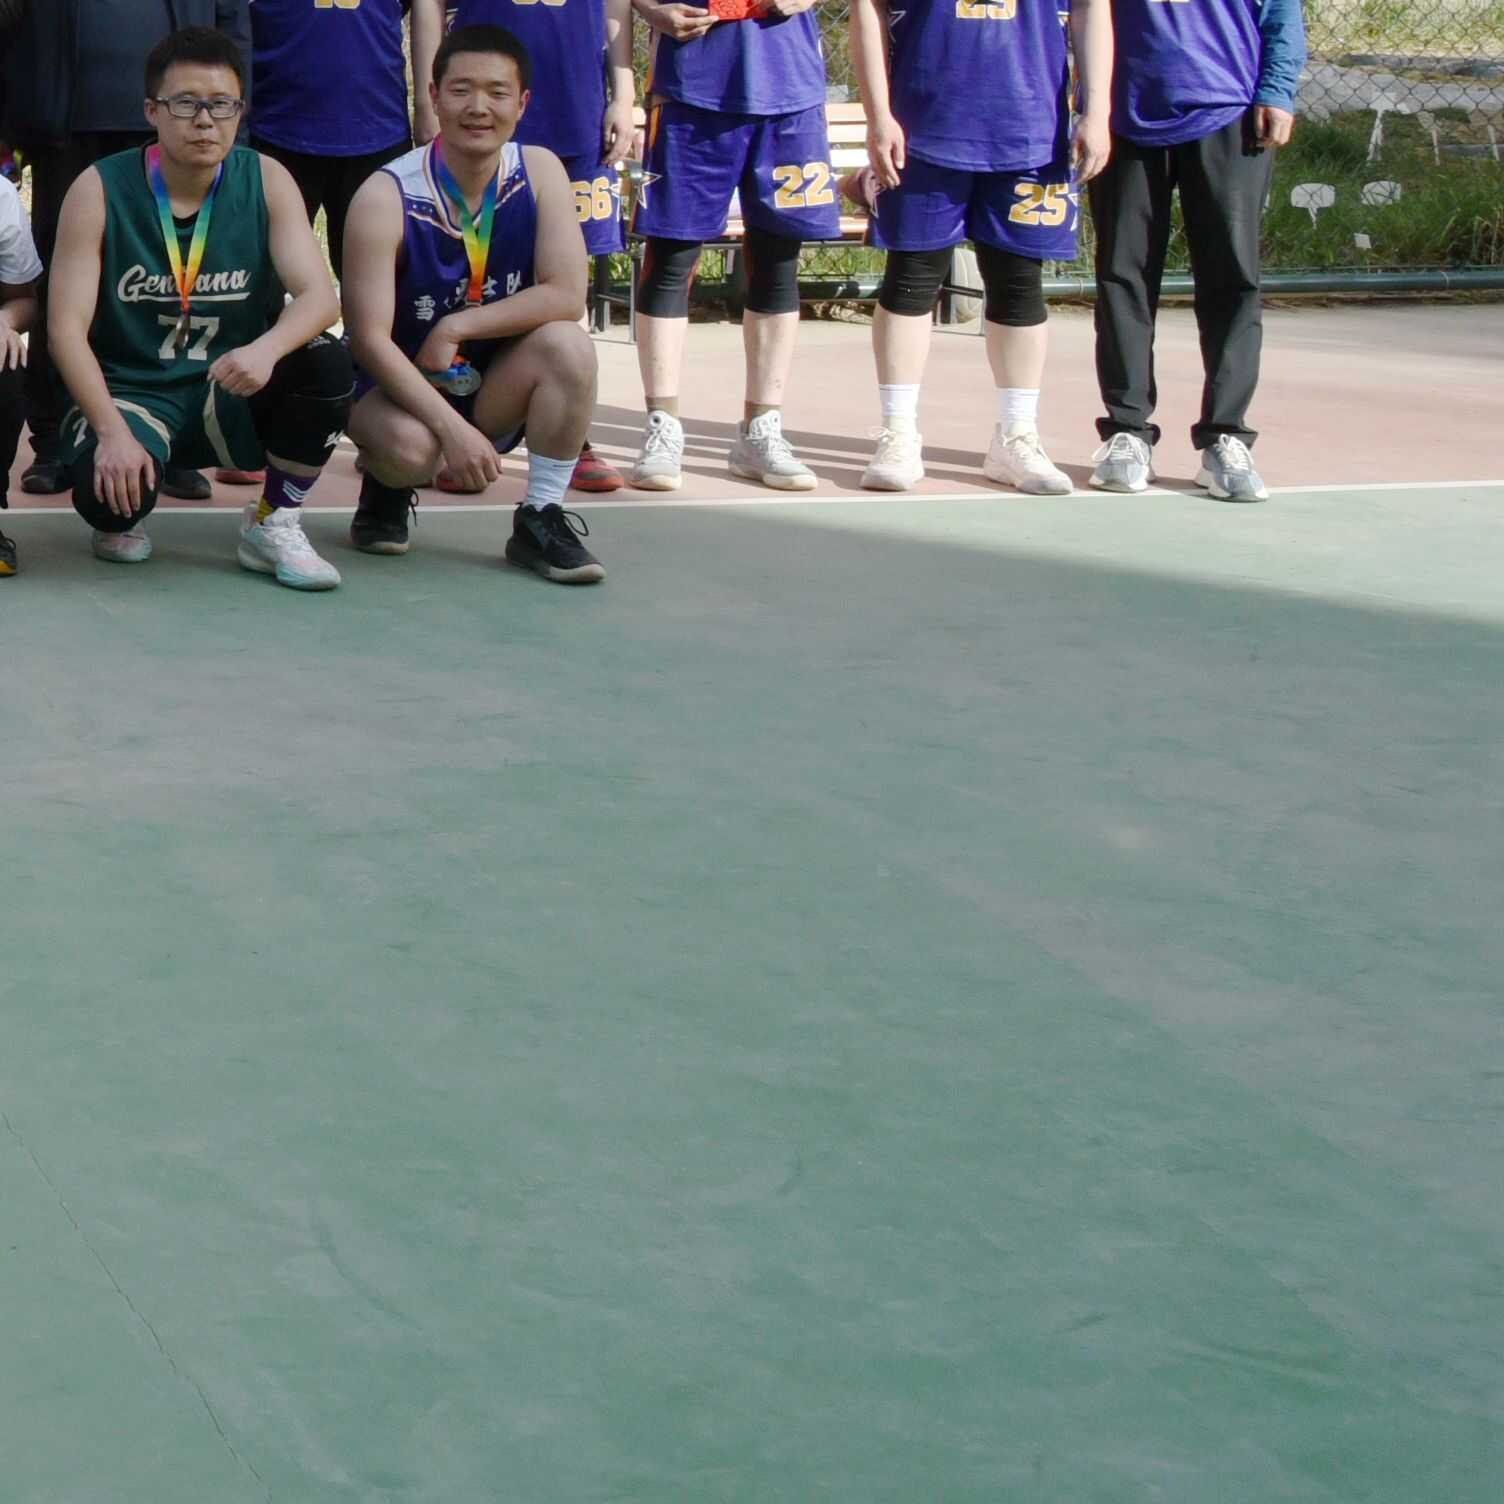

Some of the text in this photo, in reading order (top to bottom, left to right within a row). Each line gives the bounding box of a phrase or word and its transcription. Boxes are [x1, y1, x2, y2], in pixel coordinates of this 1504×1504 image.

[772, 160, 834, 209] 22
[1008, 182, 1070, 226] 25
[118, 264, 251, 303] Genana
[414, 270, 522, 321] 雪士队
[157, 314, 220, 361] 77
